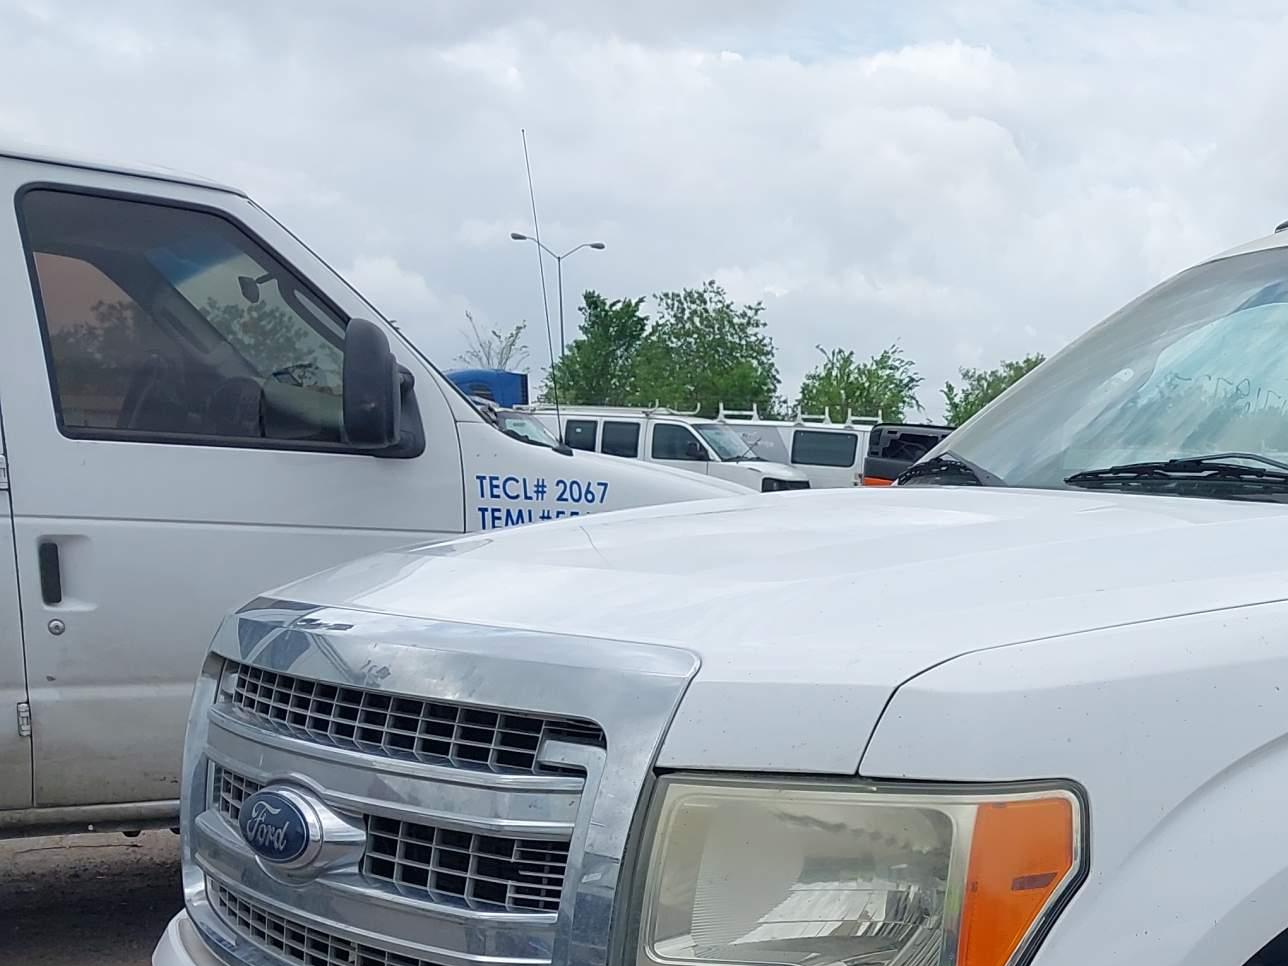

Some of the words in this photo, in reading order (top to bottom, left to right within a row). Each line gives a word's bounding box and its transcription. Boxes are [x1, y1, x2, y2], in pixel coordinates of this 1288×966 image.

[475, 474, 547, 501] TECL#
[555, 479, 609, 503] 2067
[246, 800, 290, 852] Ford
